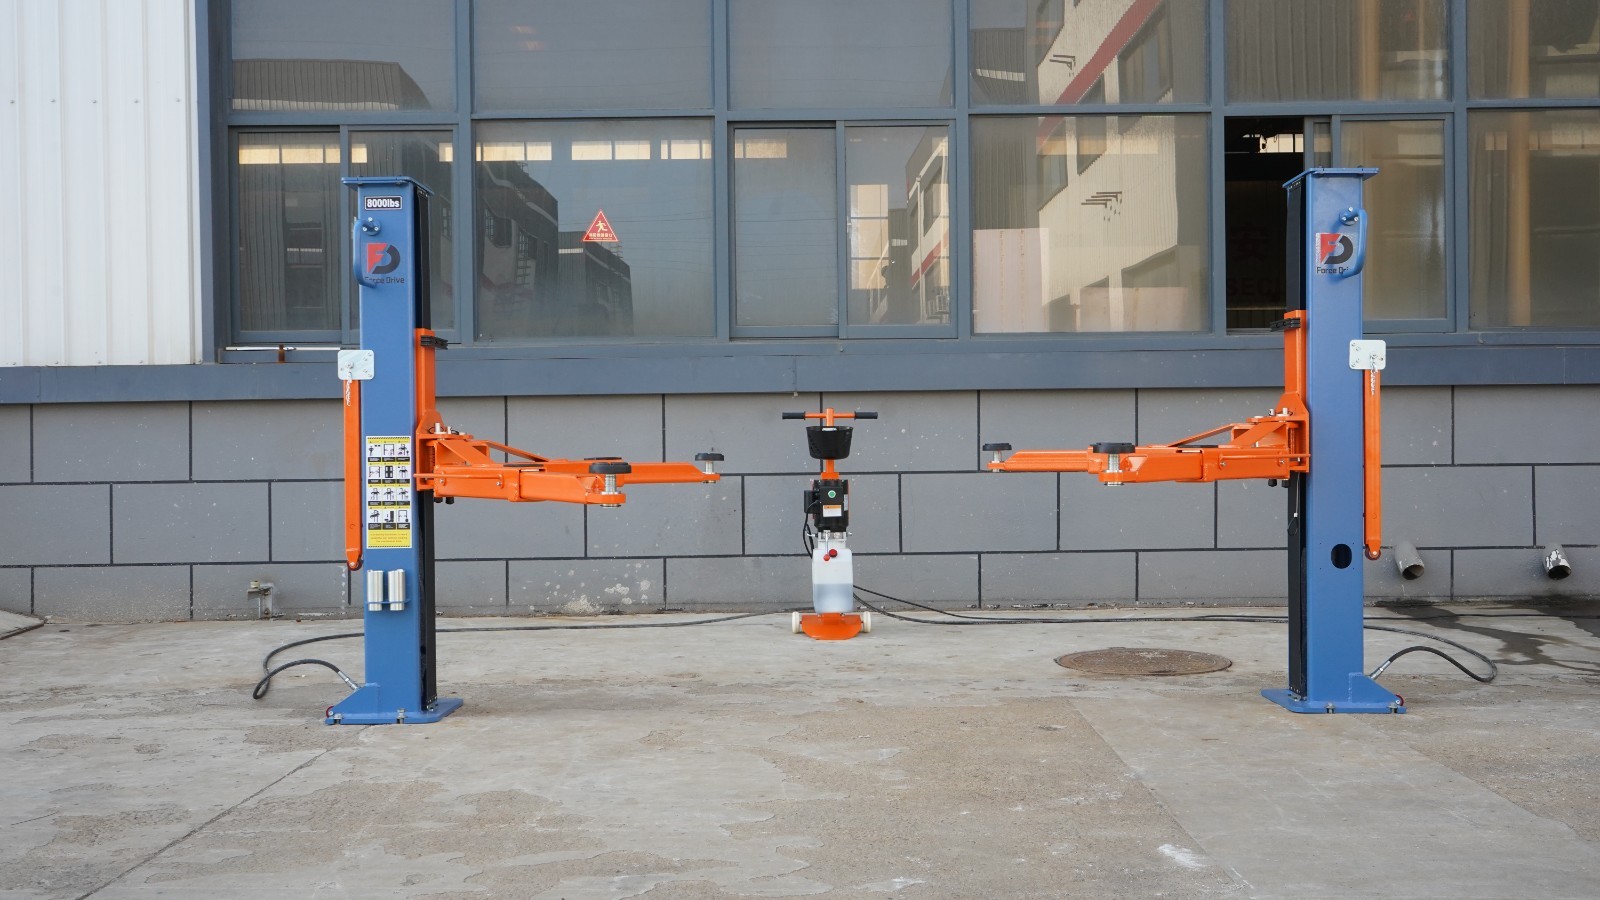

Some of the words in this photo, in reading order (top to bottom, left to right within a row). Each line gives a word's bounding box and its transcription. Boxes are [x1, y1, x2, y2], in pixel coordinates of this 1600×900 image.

[367, 198, 400, 208] 8000lbs
[1316, 266, 1337, 274] Force
[385, 276, 405, 284] Drive
